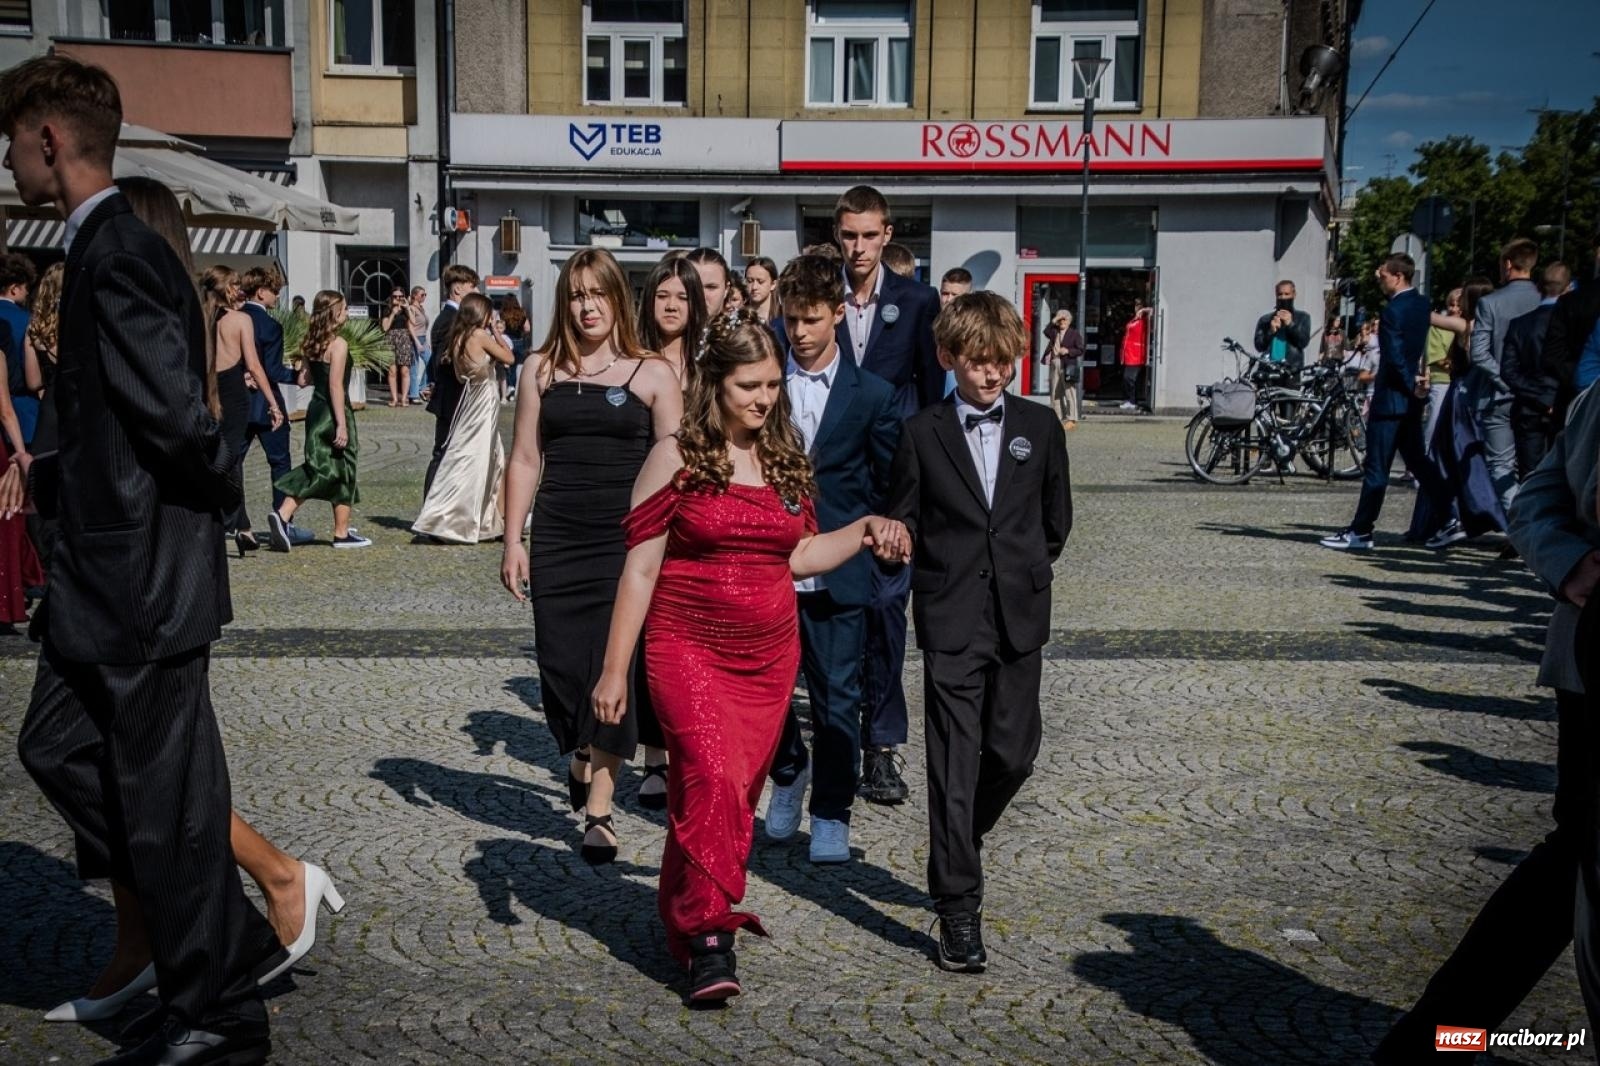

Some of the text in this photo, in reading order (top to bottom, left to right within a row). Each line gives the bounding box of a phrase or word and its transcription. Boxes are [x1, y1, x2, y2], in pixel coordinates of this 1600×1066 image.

[611, 124, 661, 143] TEB
[922, 123, 1171, 158] ROSSMANN
[610, 147, 661, 156] EDUKACJA
